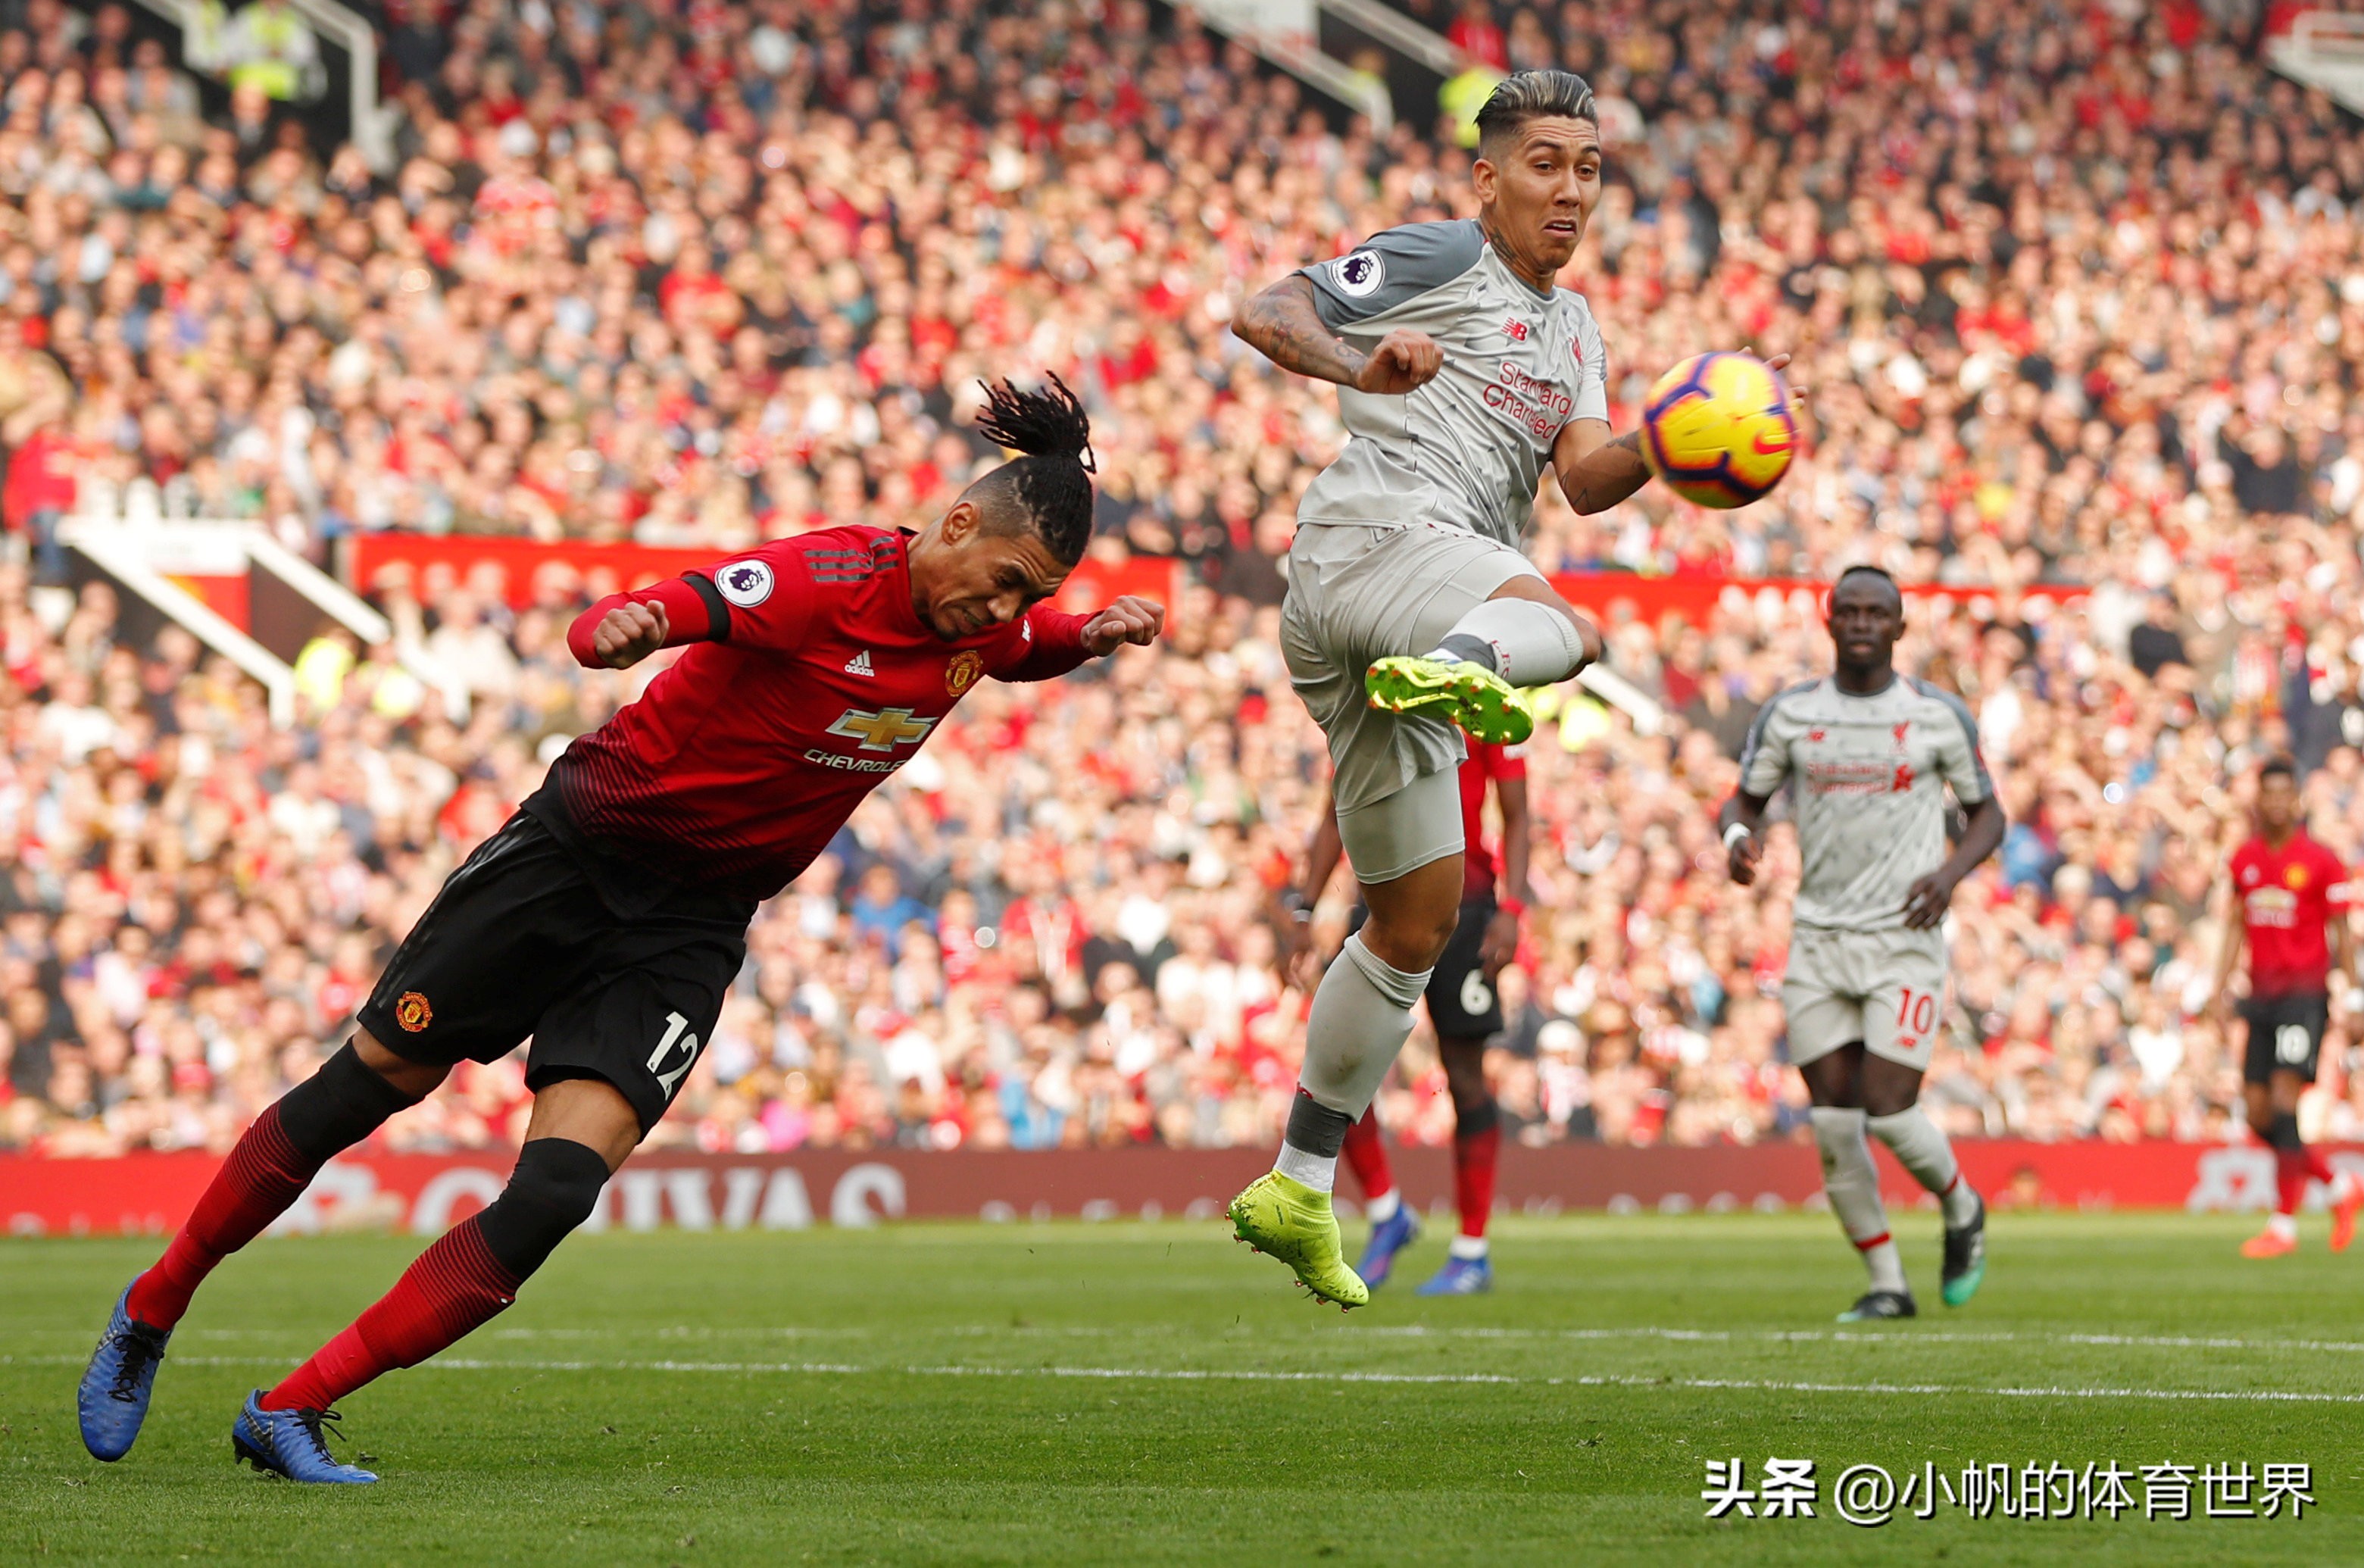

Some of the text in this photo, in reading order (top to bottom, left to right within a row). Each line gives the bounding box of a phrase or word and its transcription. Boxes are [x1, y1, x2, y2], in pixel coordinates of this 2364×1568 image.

[845, 664, 876, 677] adidas
[1460, 968, 1493, 1016] 6
[1897, 988, 1934, 1035] 10
[645, 1010, 698, 1101] 12
[2275, 1024, 2310, 1064] 10
[412, 1164, 908, 1235] CIVAS
